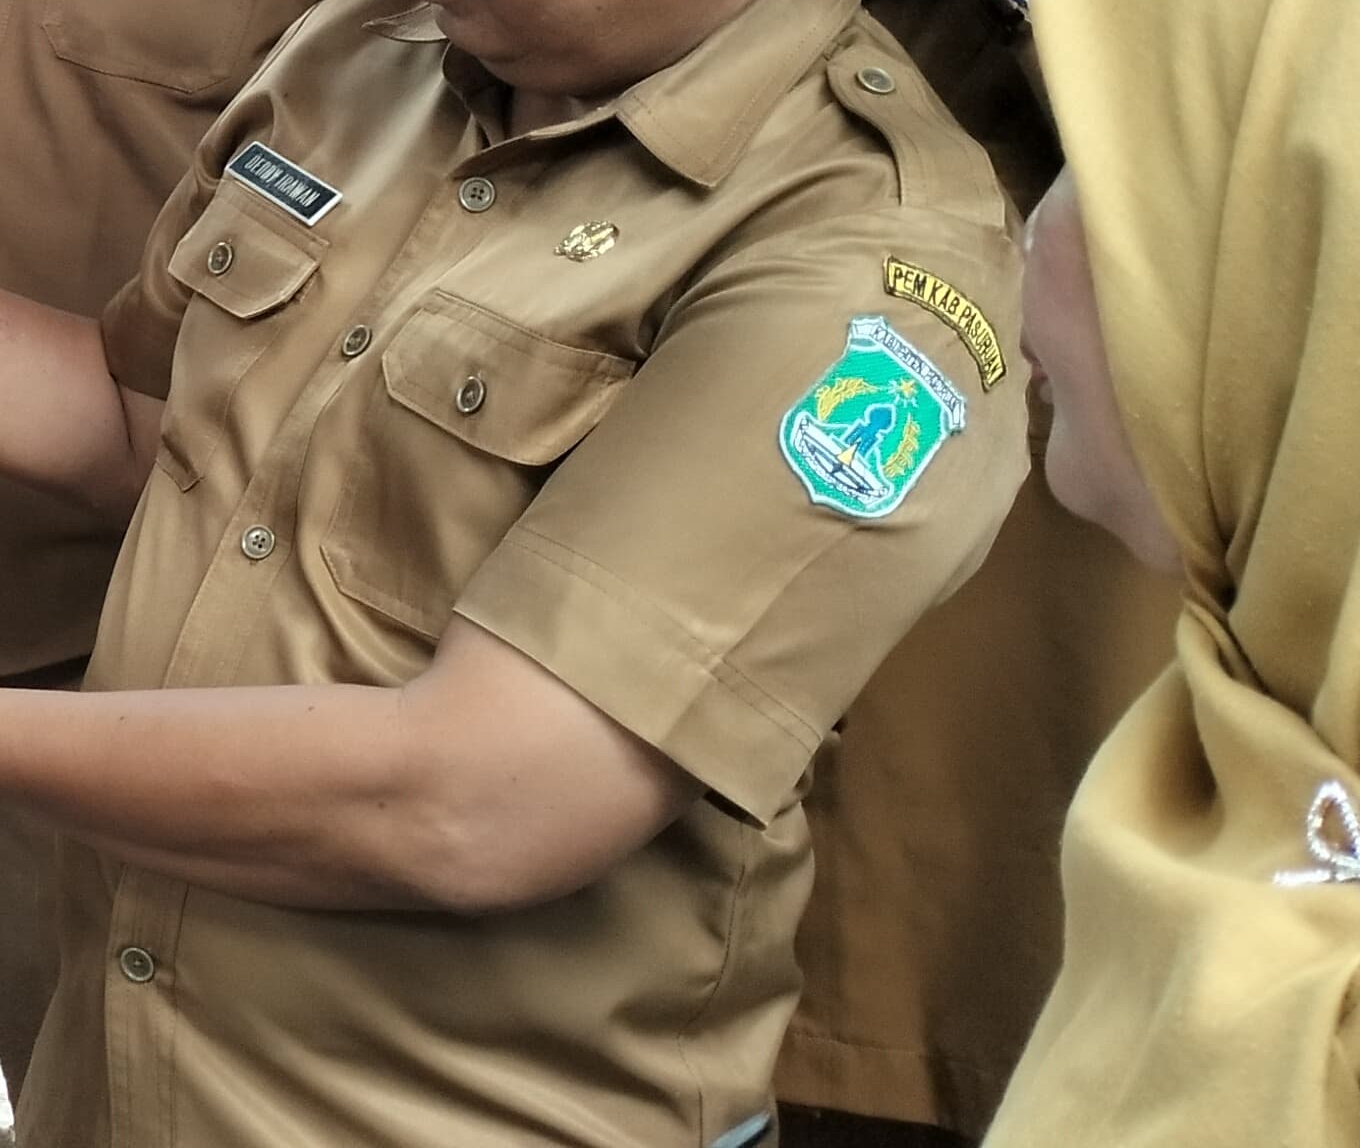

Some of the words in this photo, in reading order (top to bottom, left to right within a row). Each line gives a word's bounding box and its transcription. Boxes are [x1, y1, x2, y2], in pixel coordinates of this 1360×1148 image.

[278, 170, 320, 209] IRAWAN
[892, 265, 927, 296] PEM
[929, 283, 961, 316] KAB
[960, 306, 1005, 379] PASURUAN
